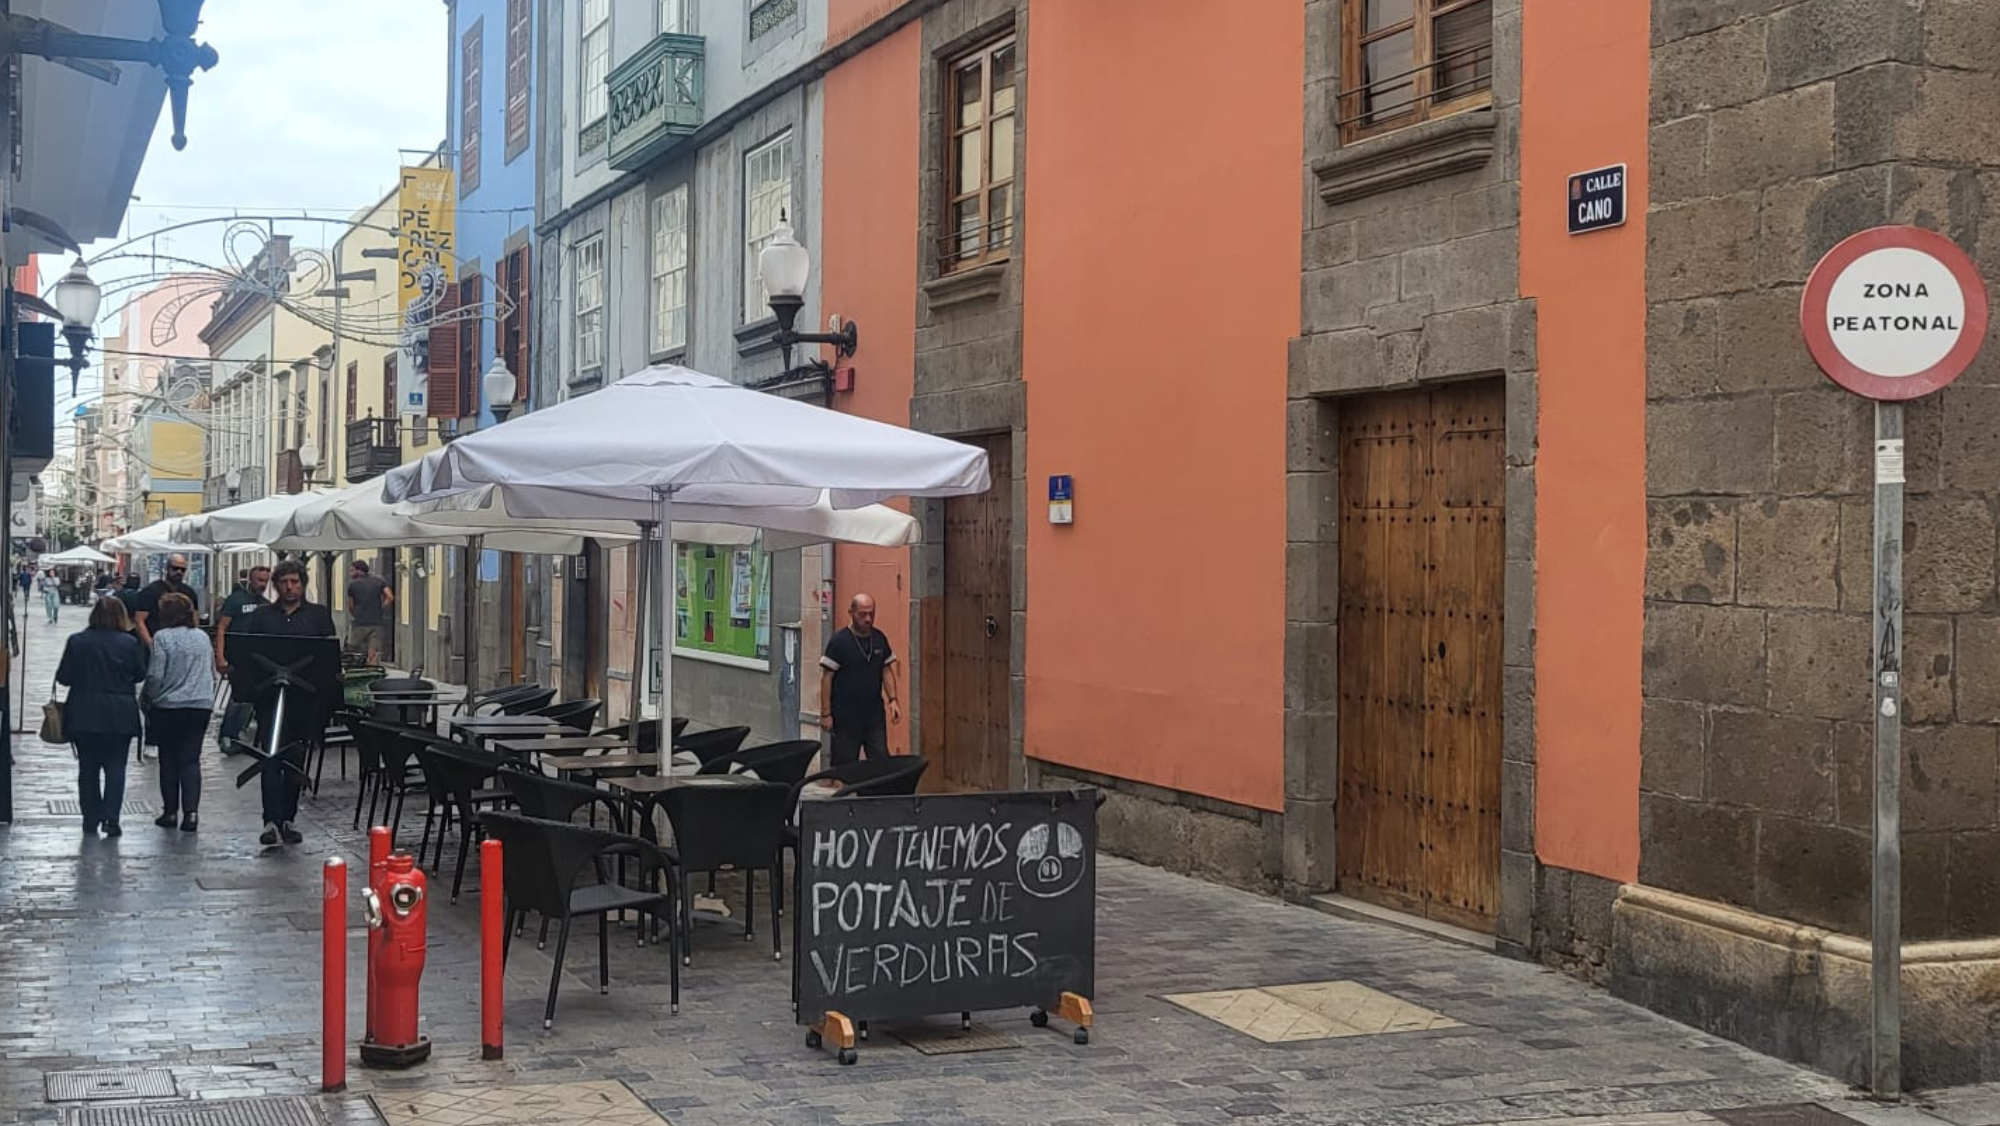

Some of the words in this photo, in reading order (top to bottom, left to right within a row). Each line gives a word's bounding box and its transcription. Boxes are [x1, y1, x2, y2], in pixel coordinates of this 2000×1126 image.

[1586, 172, 1621, 192] CALLE
[403, 203, 430, 228] PÉ
[1578, 197, 1612, 224] CANO
[410, 230, 452, 250] REZ
[1863, 283, 1929, 298] ZONA
[1833, 316, 1959, 331] PEATONAL
[811, 828, 884, 870] HOY
[889, 822, 1012, 871] TENEMOS
[811, 878, 973, 937] POTAJE
[979, 881, 1014, 923] DE
[809, 932, 1039, 996] VERDURAS
